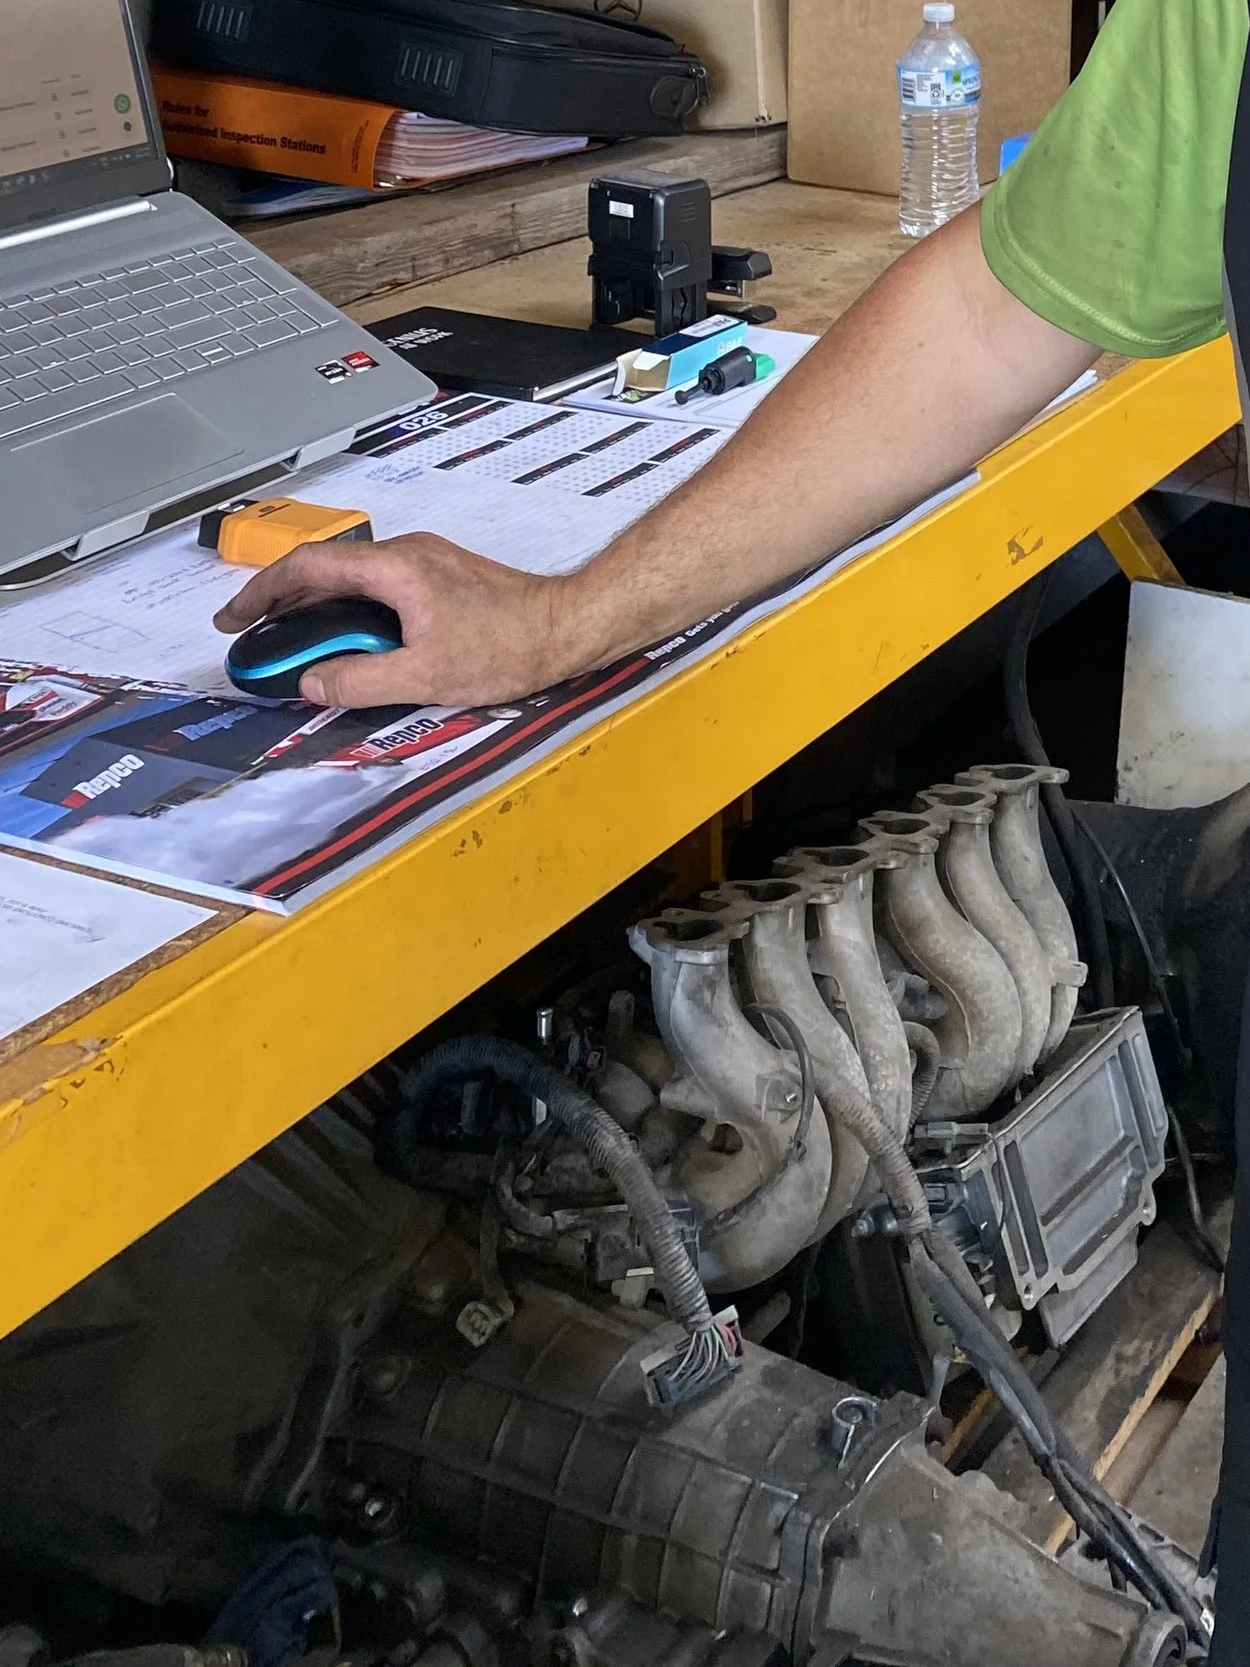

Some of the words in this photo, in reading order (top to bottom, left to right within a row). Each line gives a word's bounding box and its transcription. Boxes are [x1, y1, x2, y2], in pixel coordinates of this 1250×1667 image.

[220, 128, 277, 148] Inspection
[280, 136, 327, 155] Stations
[371, 716, 445, 753] Repco
[72, 753, 145, 800] Repco
